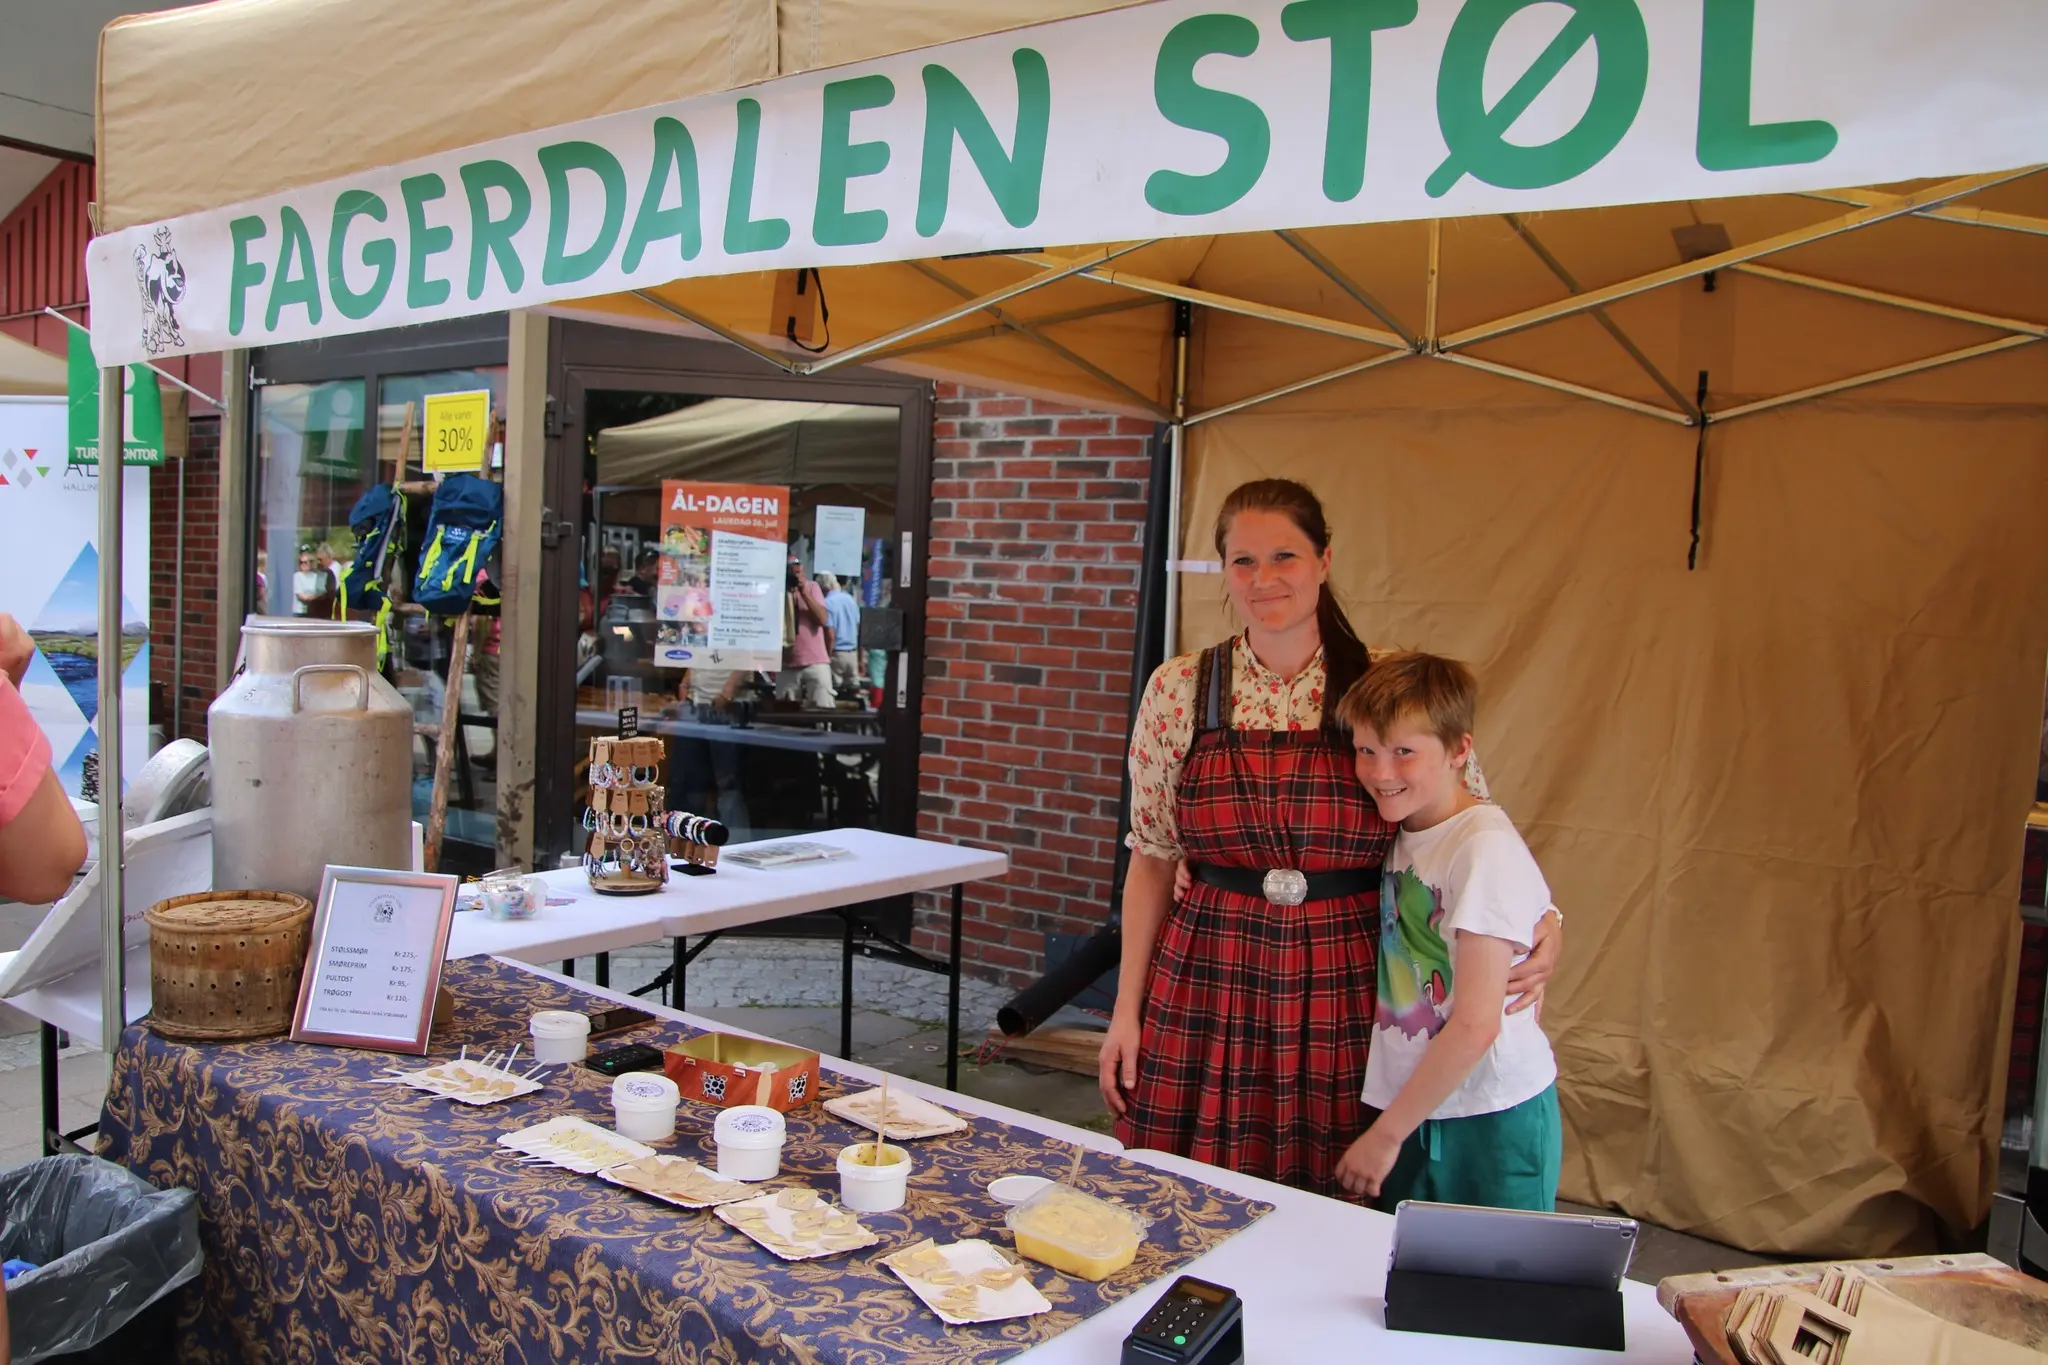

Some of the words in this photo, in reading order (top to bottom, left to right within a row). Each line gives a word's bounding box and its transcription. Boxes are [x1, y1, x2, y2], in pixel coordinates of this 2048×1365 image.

[229, 49, 1050, 335] FAGERDALEN
[1145, 0, 1838, 215] STØL
[438, 426, 474, 453] 30%
[671, 488, 779, 515] ÅL-DAGEN
[331, 946, 369, 955] STØLSSMØR
[328, 960, 367, 969] SMØREPRIM
[325, 974, 354, 983] PULTOST
[323, 989, 352, 997] TRØGOST
